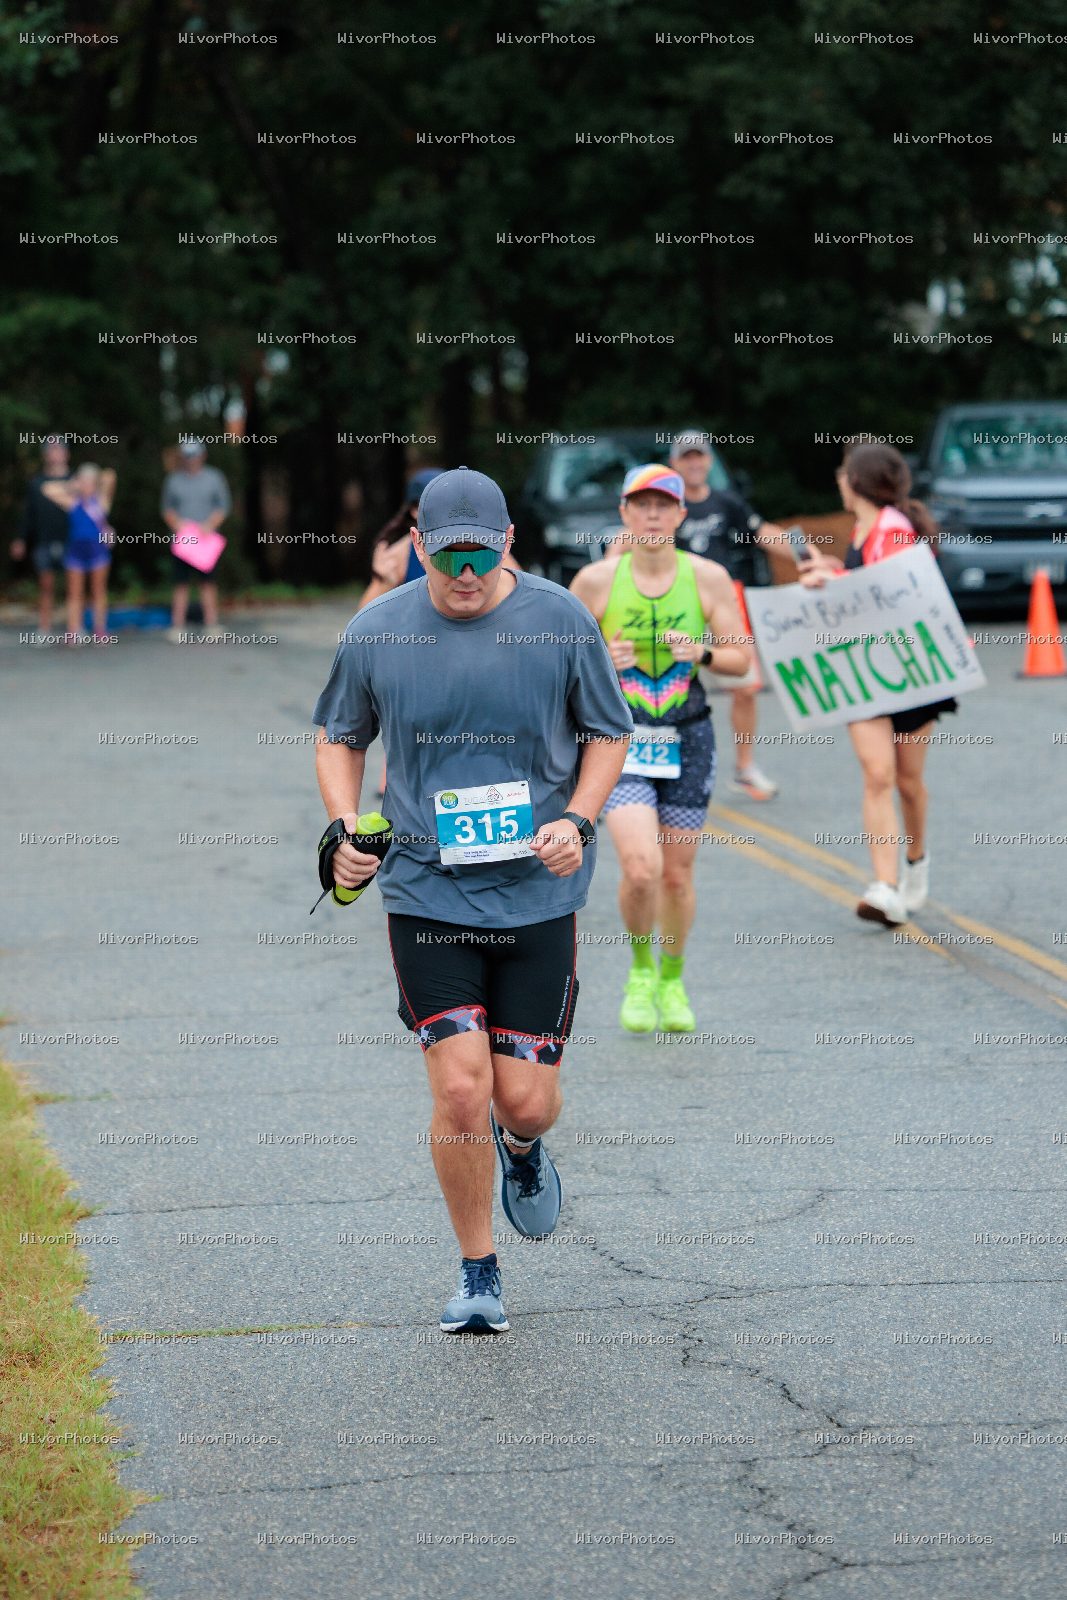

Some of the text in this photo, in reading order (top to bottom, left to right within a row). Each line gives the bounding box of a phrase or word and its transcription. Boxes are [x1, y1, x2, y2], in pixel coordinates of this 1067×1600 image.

[774, 620, 956, 716] MATCHA
[627, 744, 669, 765] 242
[454, 809, 519, 844] 315
